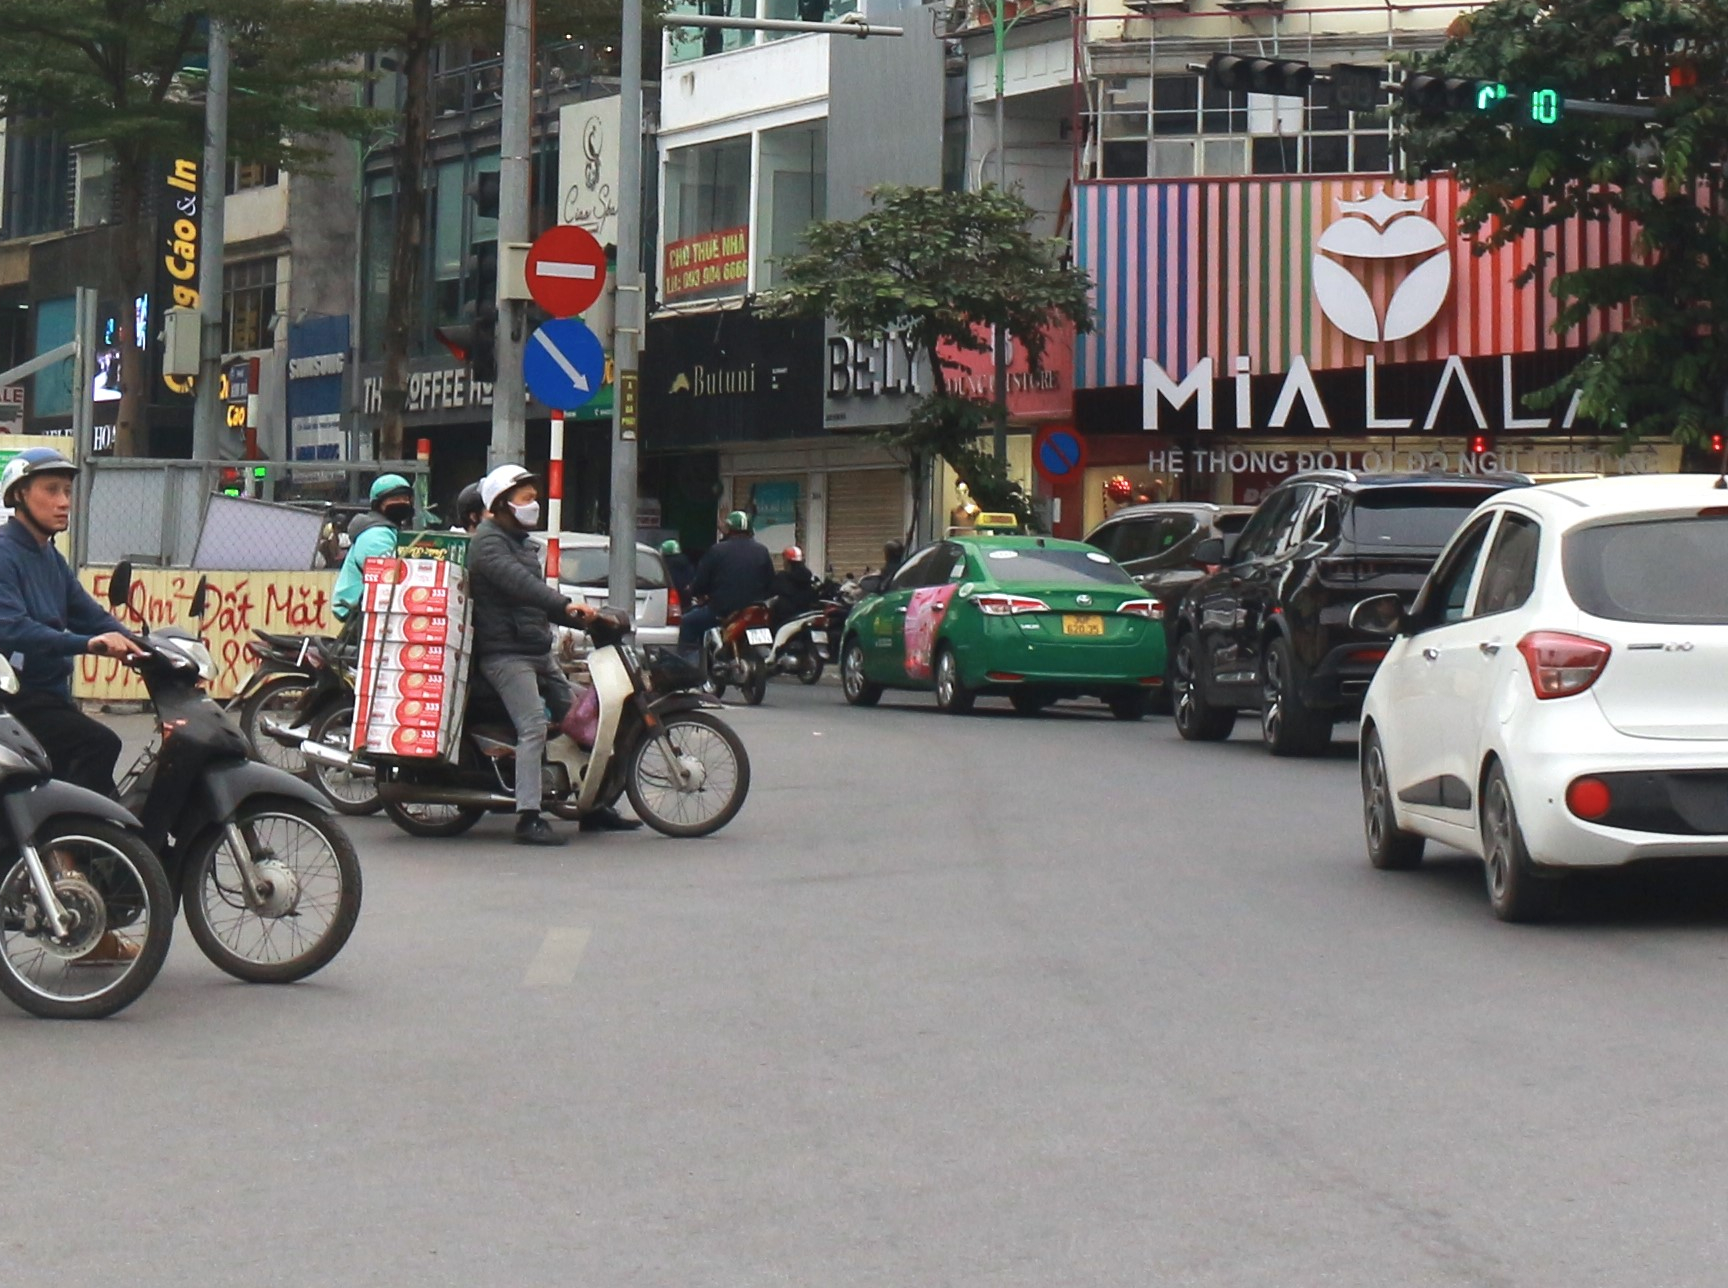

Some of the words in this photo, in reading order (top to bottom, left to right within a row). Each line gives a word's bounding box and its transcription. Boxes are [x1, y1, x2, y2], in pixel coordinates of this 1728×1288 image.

[1532, 88, 1557, 124] 10
[166, 158, 197, 193] In
[176, 195, 197, 217] &
[164, 218, 197, 281] Cáo
[669, 244, 690, 270] CHO
[692, 234, 719, 263] THUÊ
[721, 228, 746, 257] NHÀ
[289, 353, 344, 380] SAMSUNG
[828, 330, 922, 399] BELY
